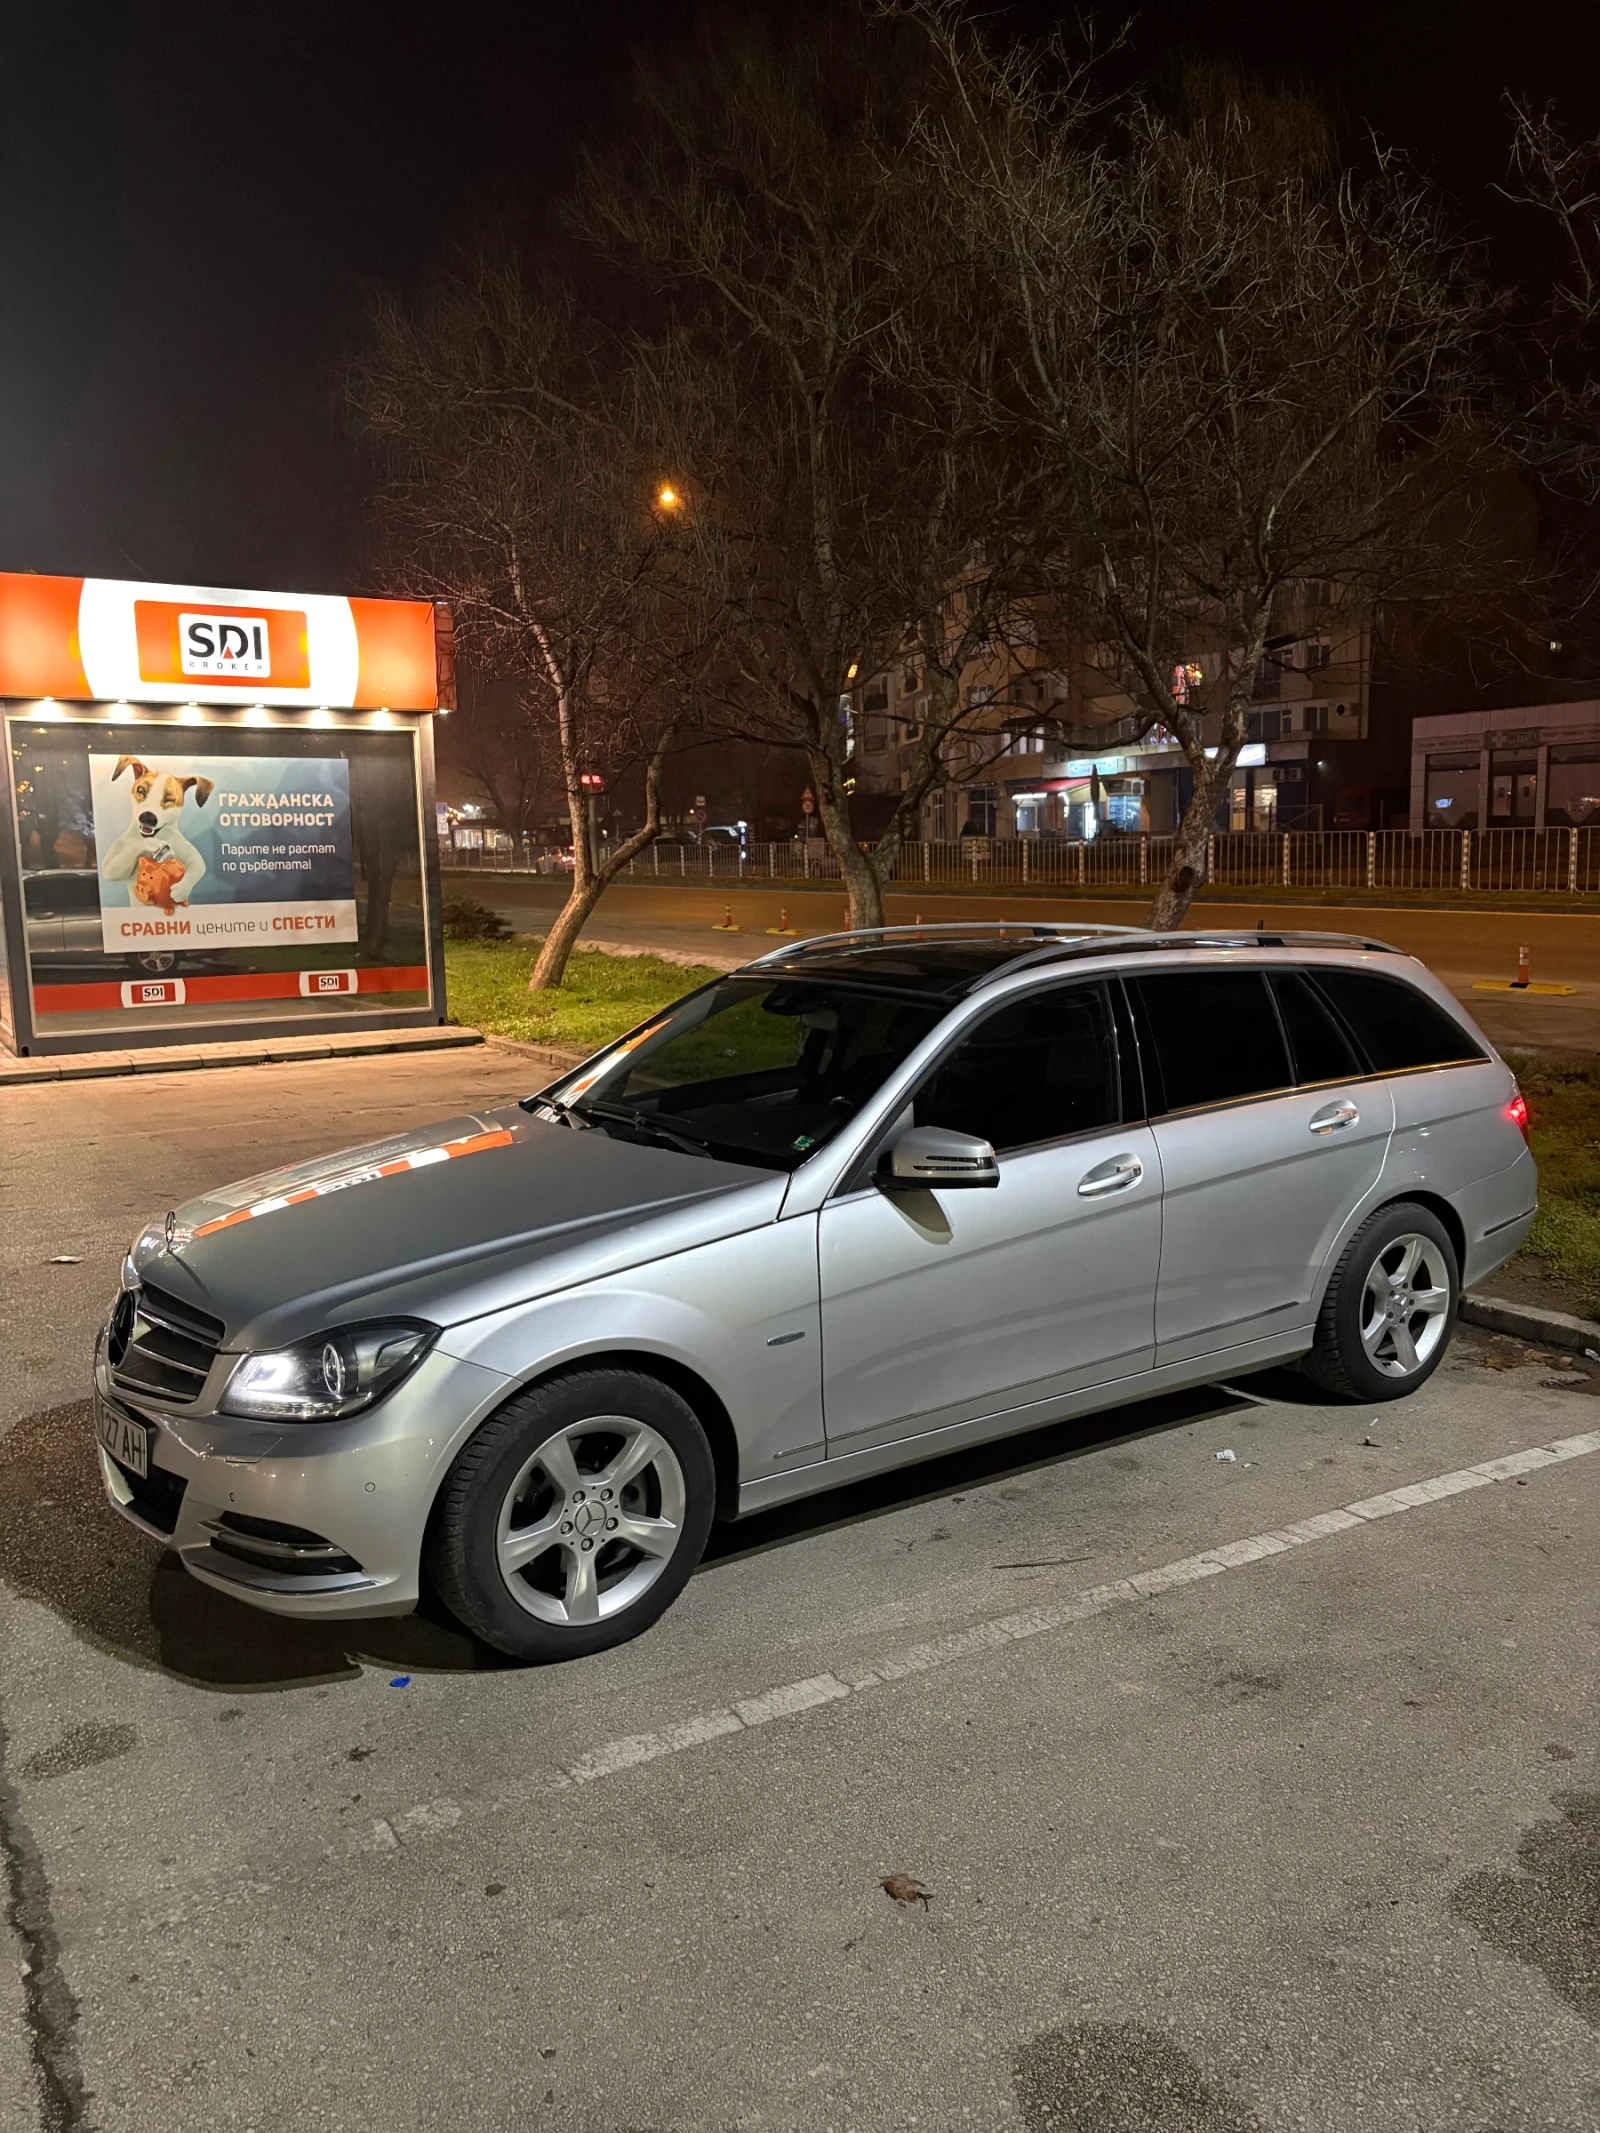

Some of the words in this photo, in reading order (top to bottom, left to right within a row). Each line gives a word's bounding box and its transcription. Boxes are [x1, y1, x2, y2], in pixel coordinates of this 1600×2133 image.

[187, 622, 262, 660] SDI
[218, 793, 334, 809] ГРАЖДАНСКА
[219, 813, 335, 827] ОТГОВОРНОСТ
[221, 843, 270, 857] Парите
[272, 845, 286, 854] не
[288, 844, 336, 857] растат
[222, 861, 237, 871] по
[239, 858, 312, 873] дърветата!
[120, 920, 191, 937] СРАВНИ
[196, 920, 256, 935] цените
[260, 920, 269, 931] и
[272, 915, 336, 931] СПЕСТИ
[320, 977, 338, 987] SDI
[144, 987, 163, 997] SDI
[122, 1425, 142, 1469] AH
